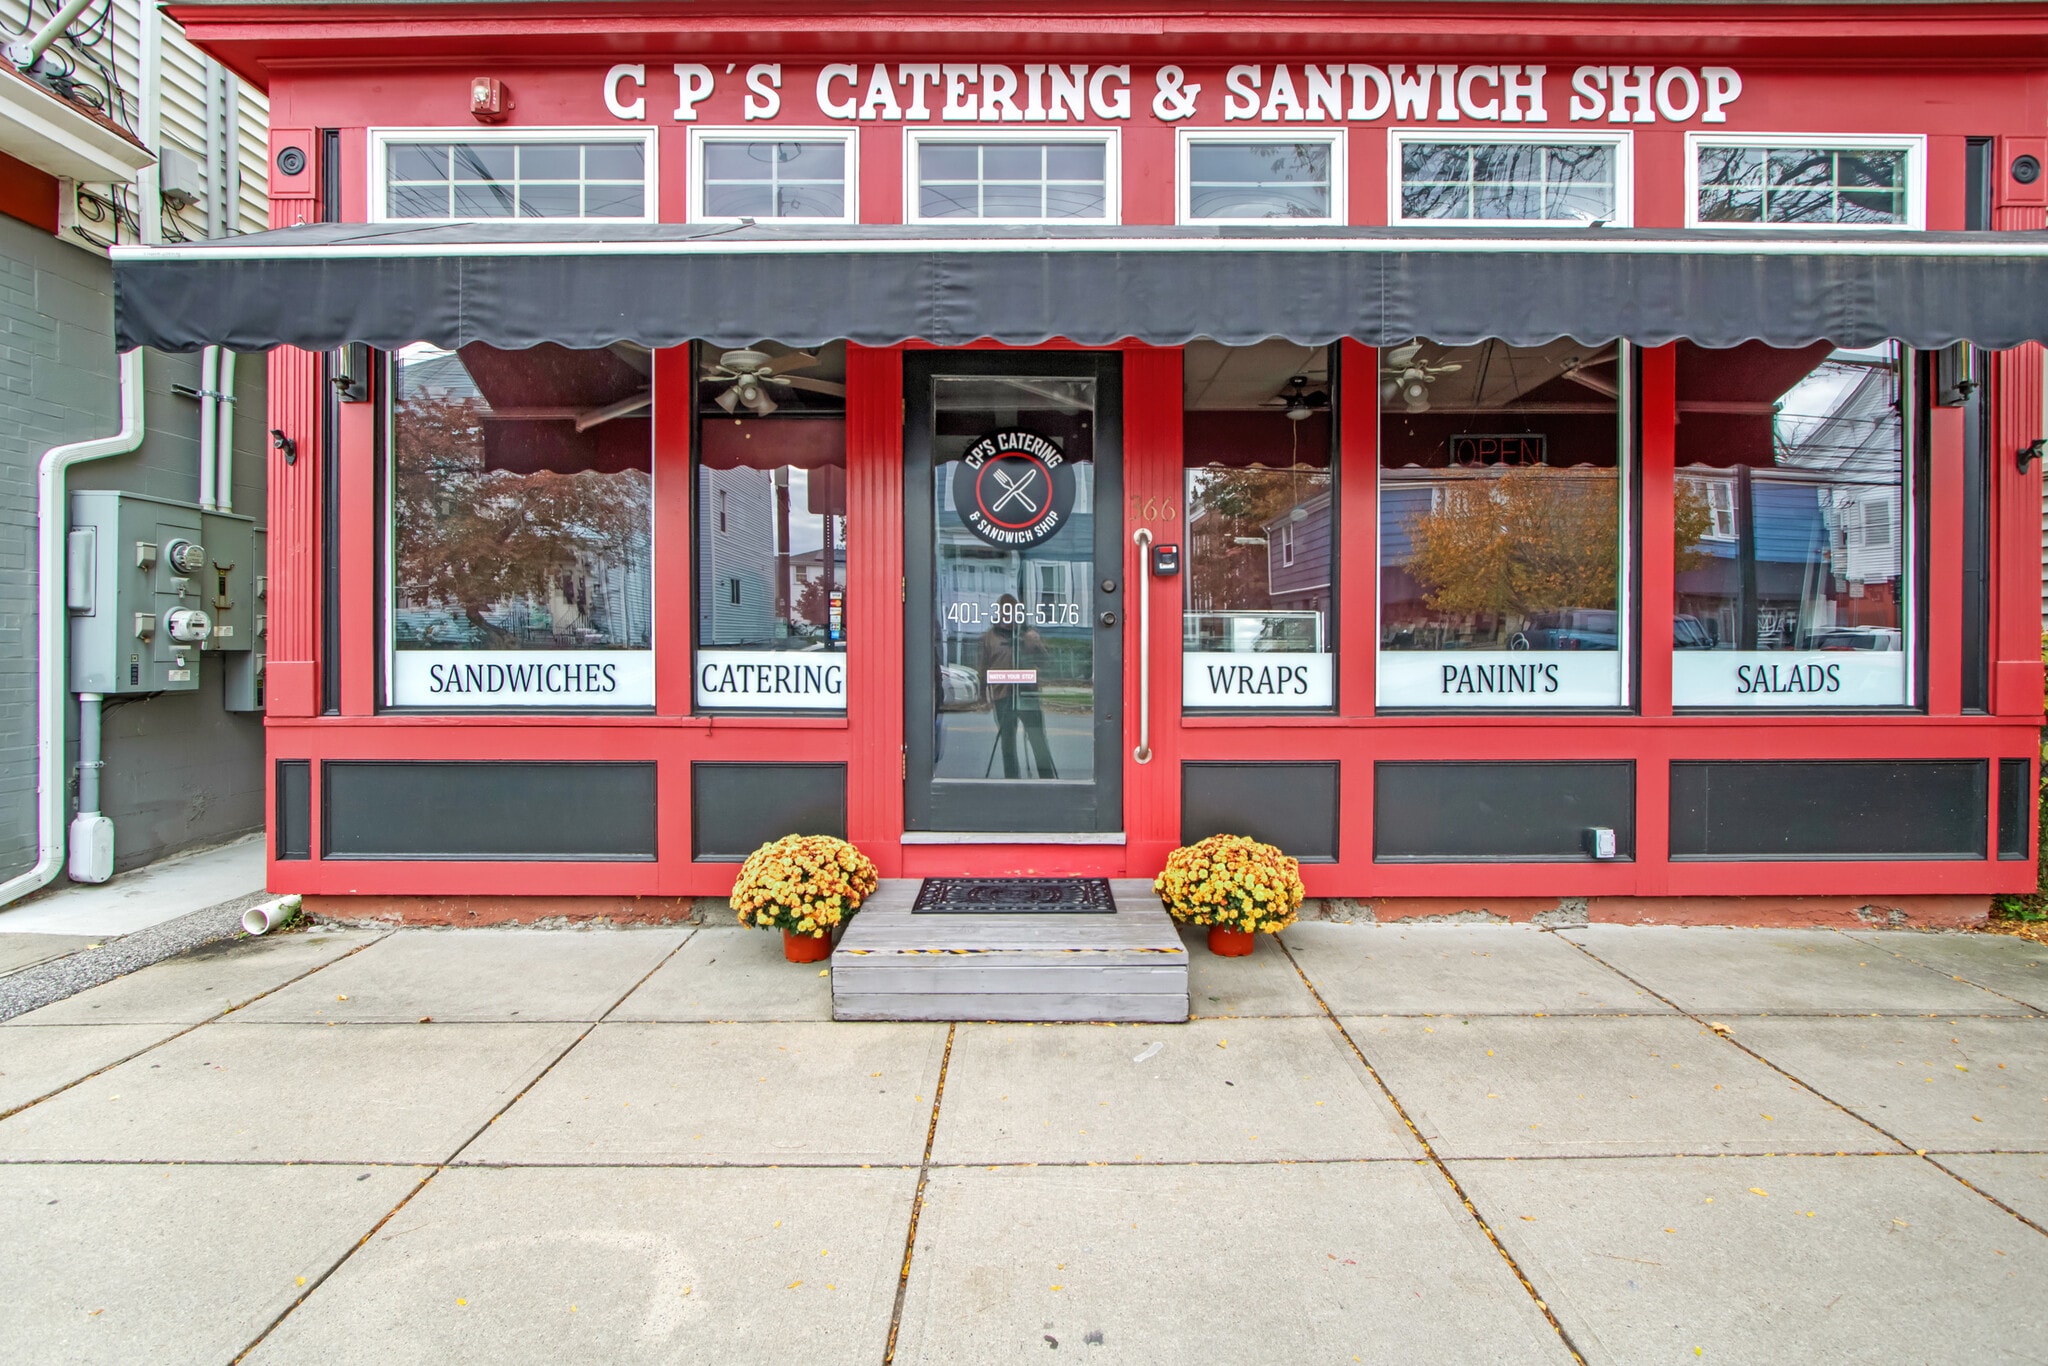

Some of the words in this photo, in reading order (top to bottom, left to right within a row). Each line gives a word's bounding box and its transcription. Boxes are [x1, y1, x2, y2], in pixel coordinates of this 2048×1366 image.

[815, 63, 1131, 121] CATERING
[1152, 64, 1202, 121] &
[1224, 63, 1548, 122] SANDWICH
[1569, 66, 1743, 123] SHOP
[965, 438, 996, 470] CP'S
[997, 432, 1063, 469] CATERING
[1457, 439, 1540, 468] OPEN
[969, 510, 981, 521] &
[977, 519, 1034, 544] SANDWICH
[1036, 510, 1060, 537] SHOP
[947, 602, 1080, 625] 401-396-5176
[430, 663, 616, 693] SANDWICHES
[701, 663, 842, 694] CATERING
[1207, 665, 1308, 695] WRAPS
[1442, 663, 1559, 694] PANINI'S
[1737, 663, 1841, 694] SALADS
